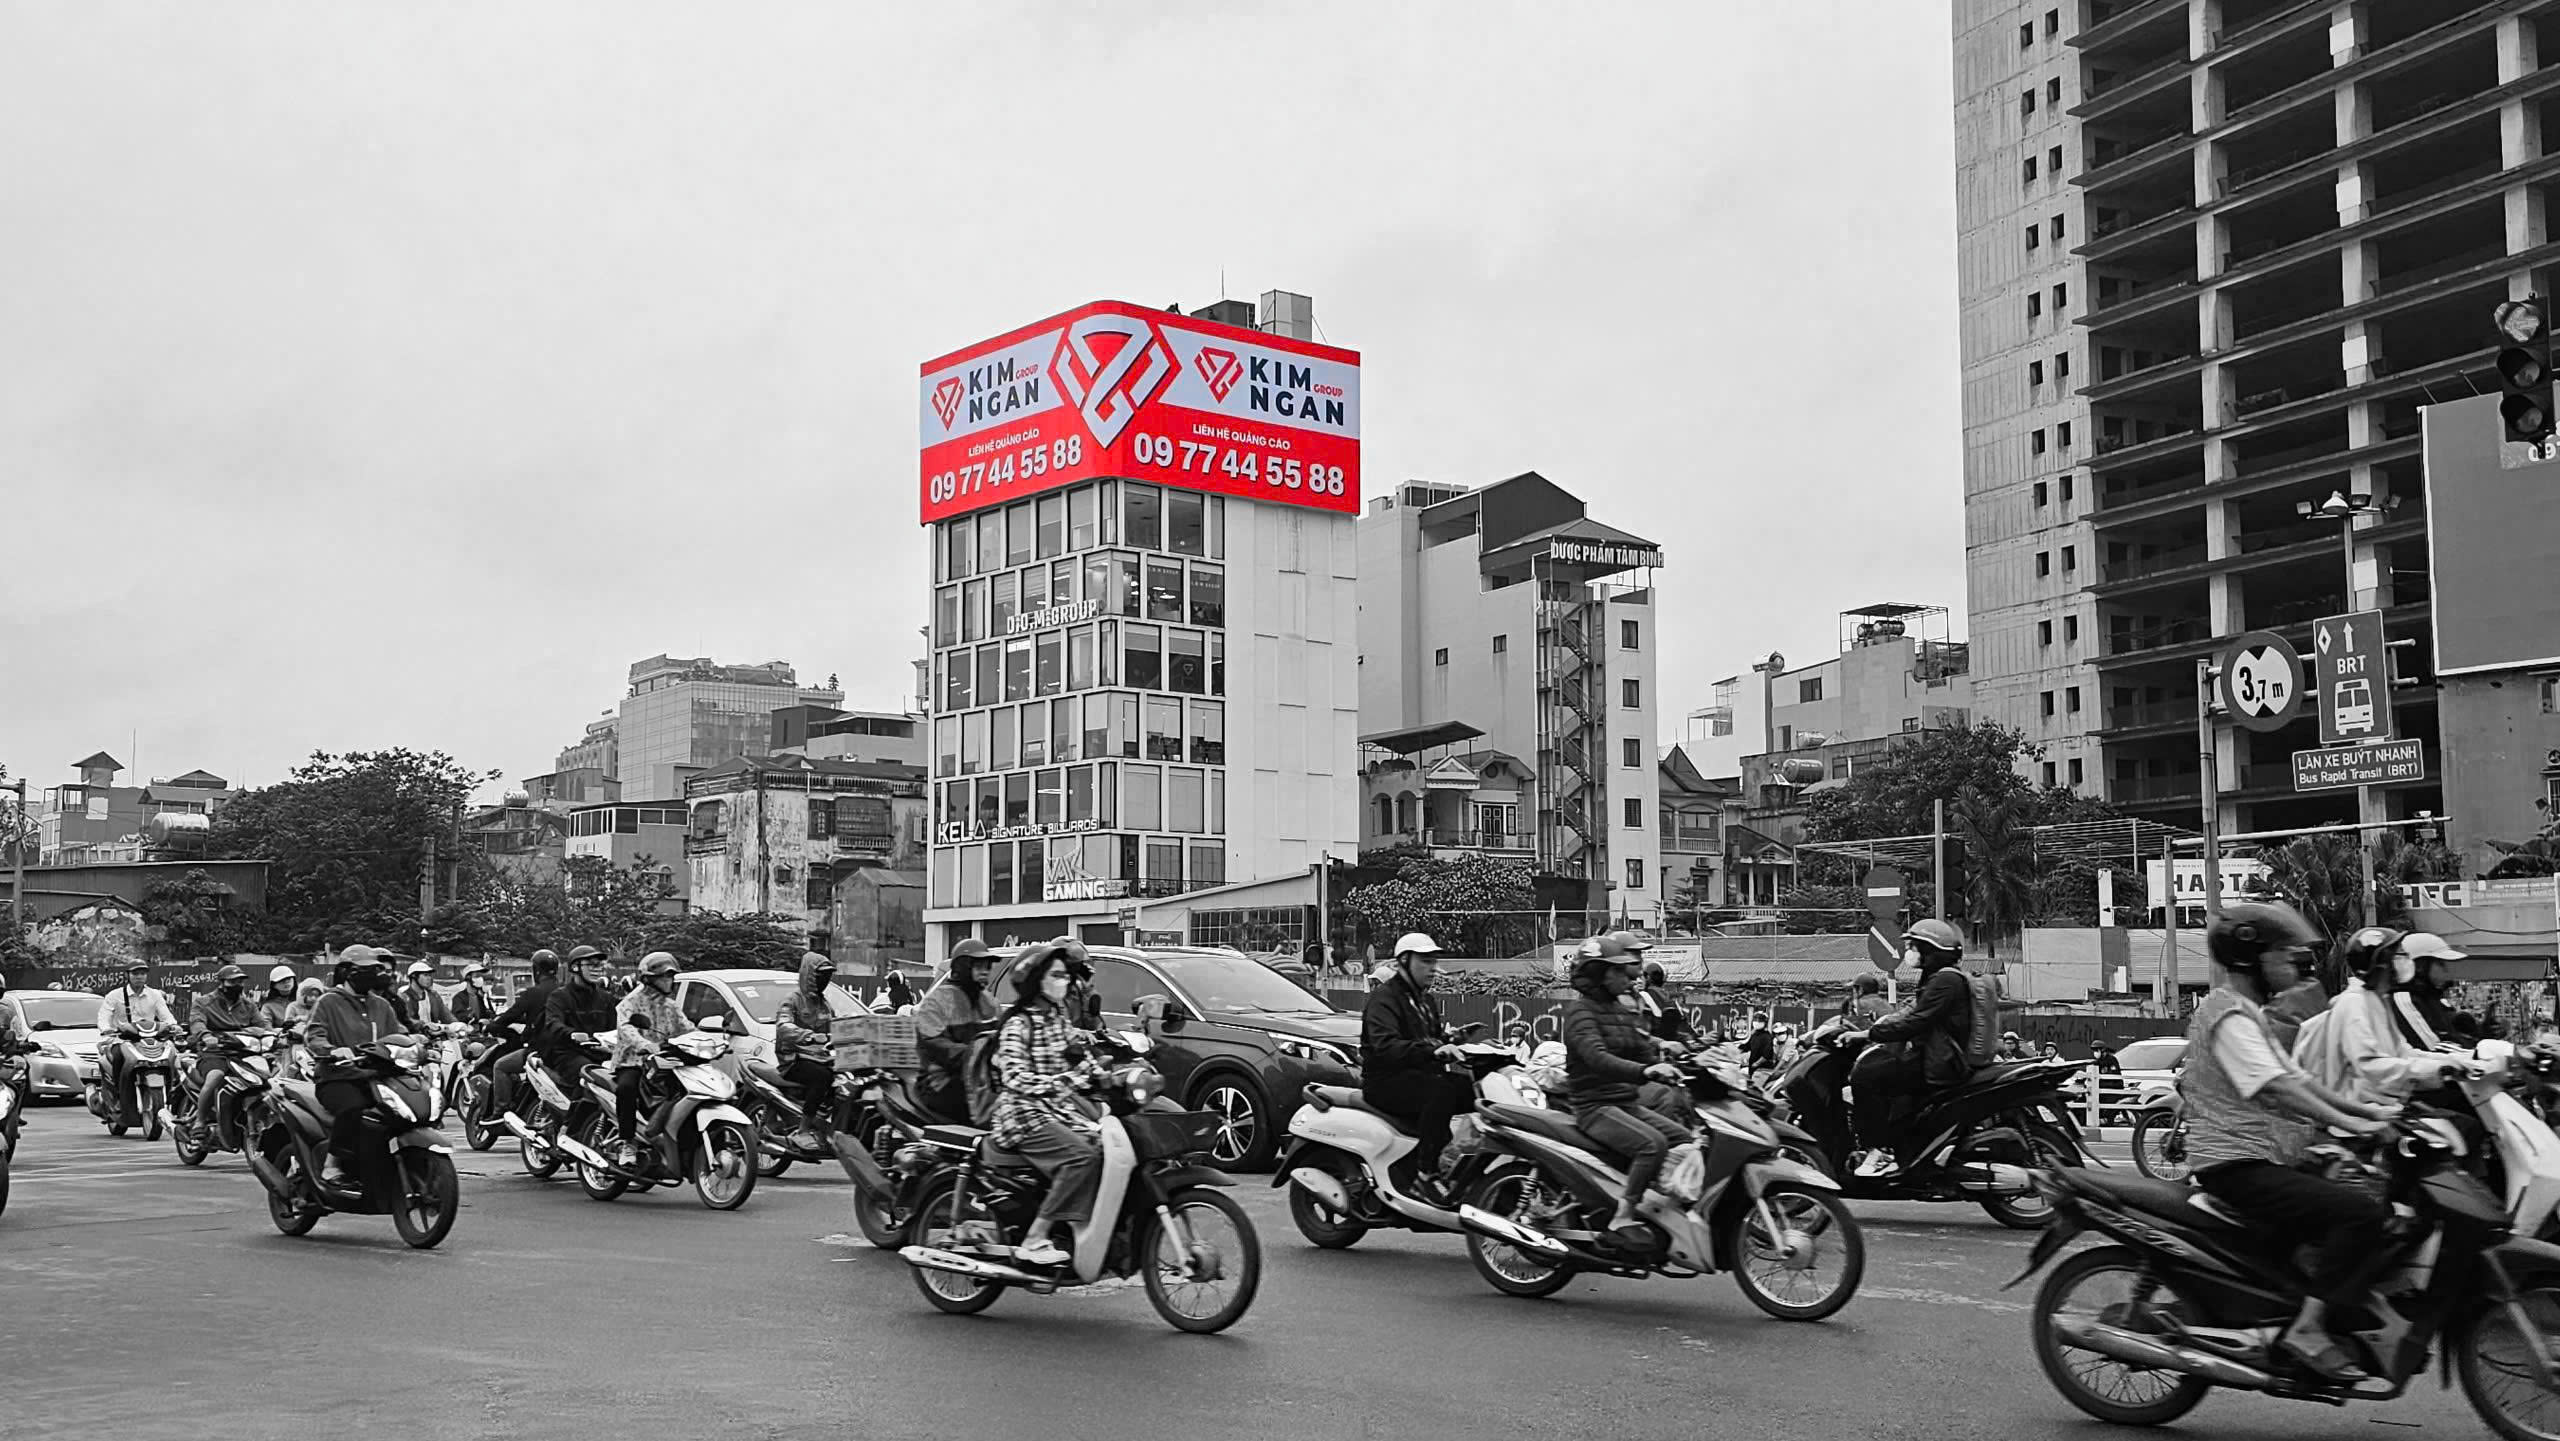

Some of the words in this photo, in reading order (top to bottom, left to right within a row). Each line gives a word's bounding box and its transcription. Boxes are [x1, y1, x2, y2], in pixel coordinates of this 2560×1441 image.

[969, 357, 1014, 395] KIM
[1015, 364, 1039, 380] GROUP
[1250, 356, 1311, 392] KIM
[969, 377, 1039, 423] NGAN
[1313, 383, 1343, 397] GROUP
[1250, 385, 1344, 426] NGAN
[1193, 423, 1215, 437] LIÊN
[930, 471, 956, 504] 09
[1020, 444, 1047, 479] 55
[1053, 434, 1082, 469] 88
[1134, 432, 1173, 467] 09
[1266, 456, 1302, 489] 55
[1309, 463, 1345, 496] 88
[1616, 545, 1638, 566] TÂM
[2336, 655, 2366, 674] BRT
[2239, 666, 2266, 703] 3,7
[2298, 754, 2321, 770] LÀN
[2324, 754, 2339, 768] XE
[2342, 748, 2372, 766] BUÝT
[2375, 745, 2417, 762] NHANH
[2299, 773, 2318, 784] Bus
[2321, 769, 2347, 784] Rapid
[2350, 767, 2382, 780] Transit
[2388, 762, 2418, 776] (BRT)
[991, 823, 1044, 839] SIGNATURE
[1047, 819, 1099, 834] BILLIARDS
[1044, 880, 1105, 900] GAMING
